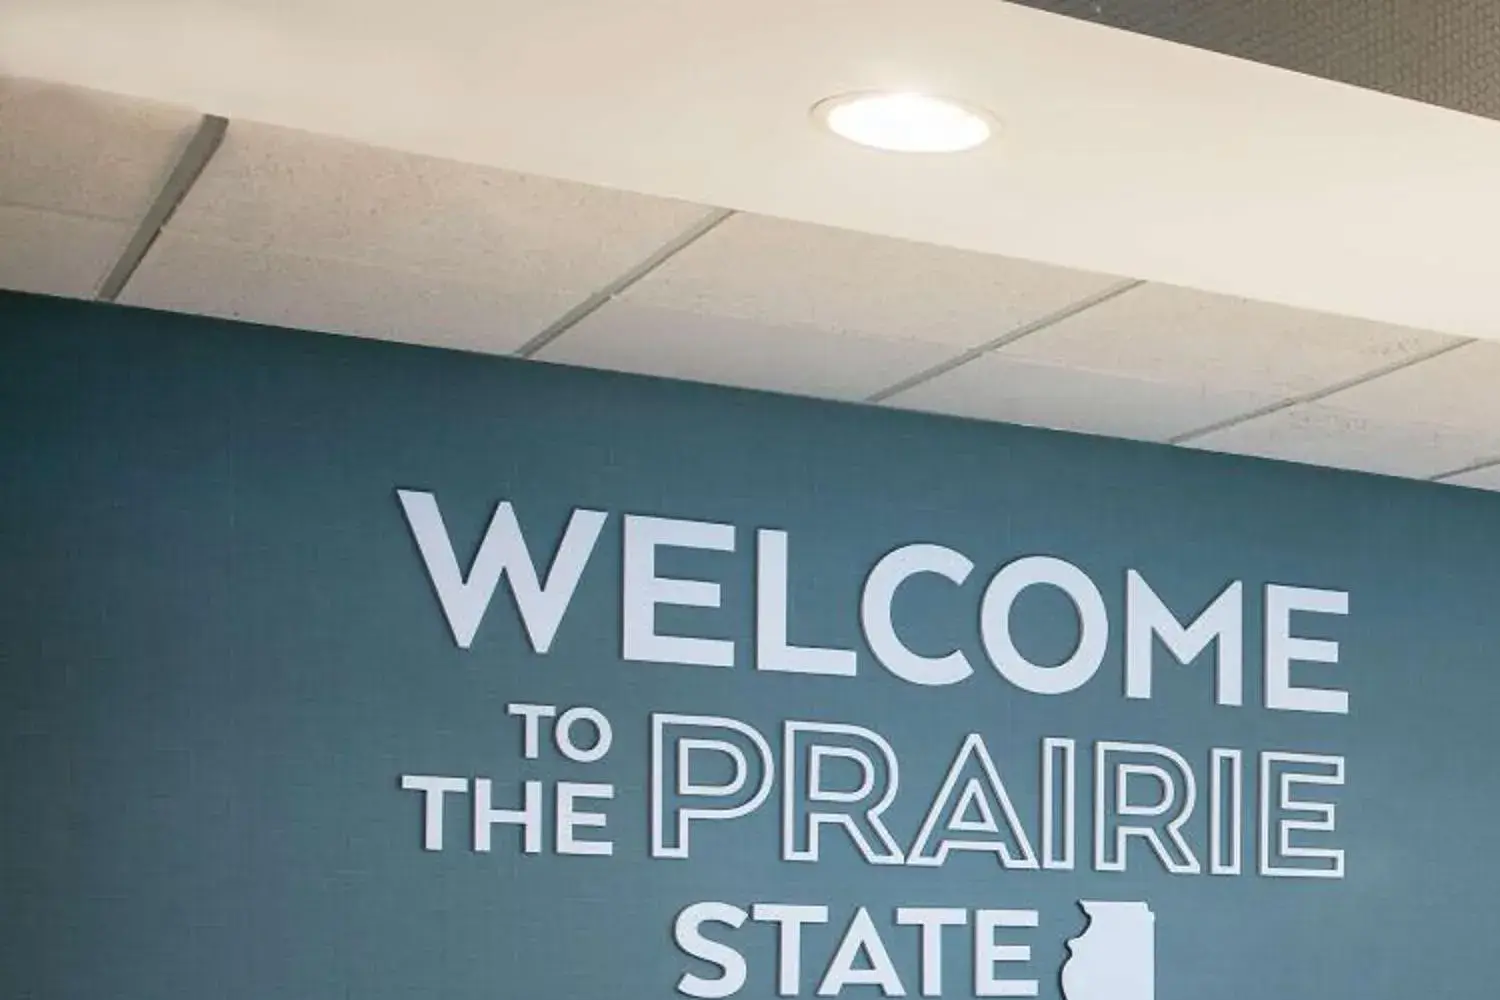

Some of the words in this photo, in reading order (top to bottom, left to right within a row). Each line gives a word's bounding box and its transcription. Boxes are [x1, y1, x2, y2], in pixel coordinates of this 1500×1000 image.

[398, 490, 1348, 714] WELCOME
[402, 775, 615, 856] THE
[652, 713, 1346, 879] PRAIRIE
[508, 703, 612, 763] TO
[675, 901, 1040, 999] STATE
